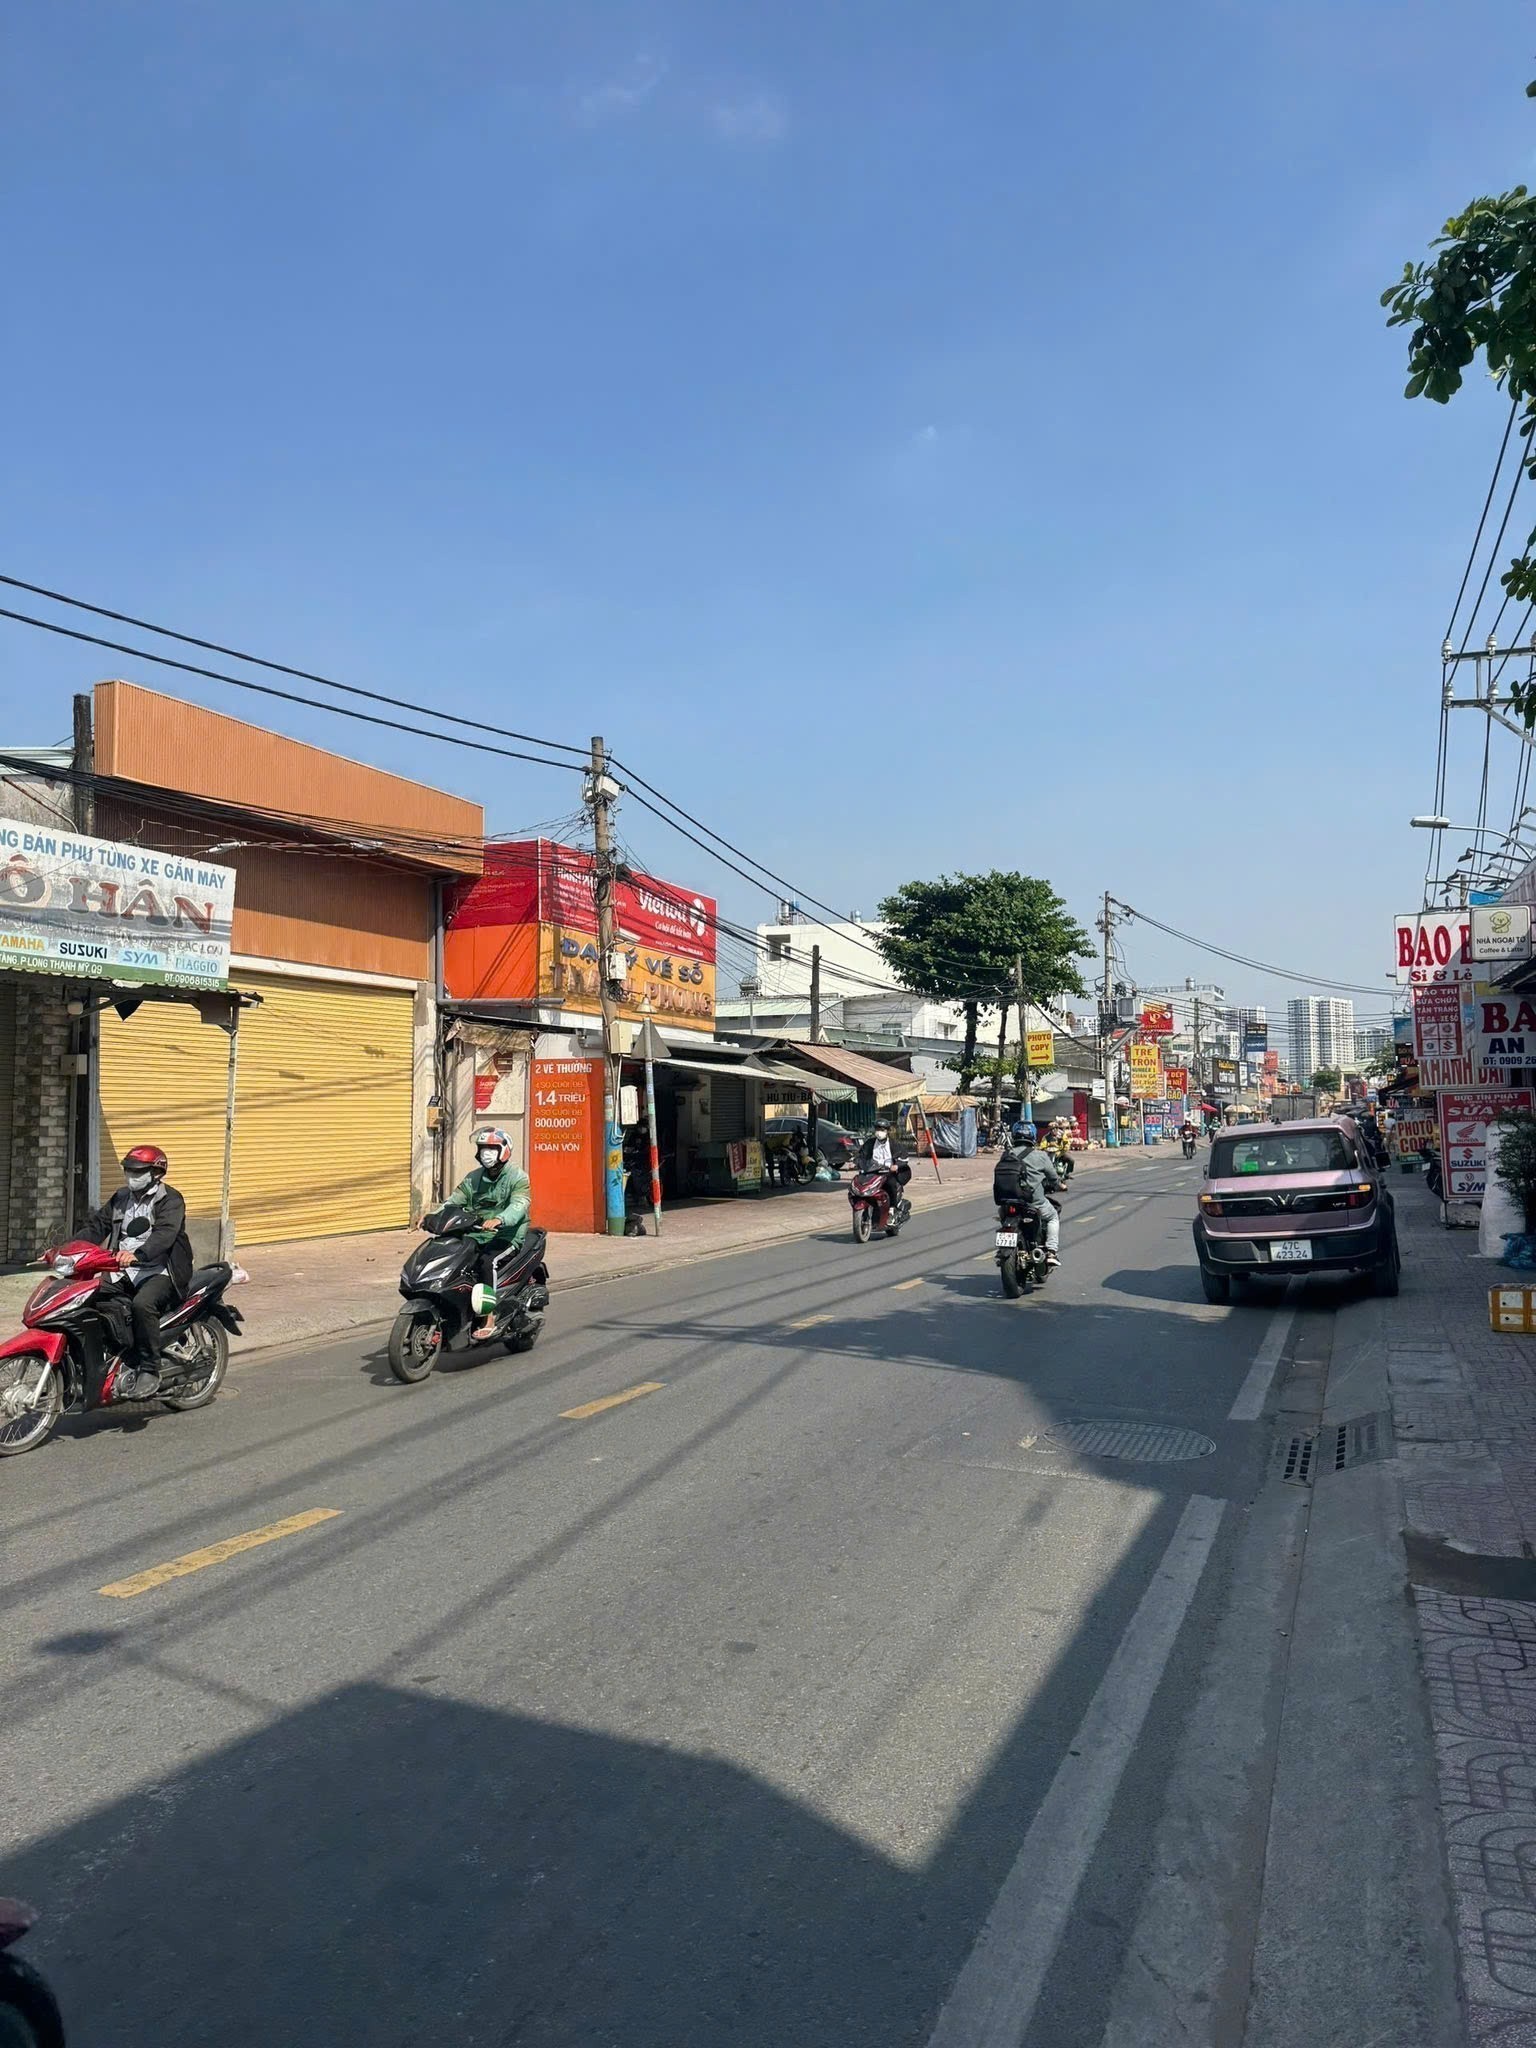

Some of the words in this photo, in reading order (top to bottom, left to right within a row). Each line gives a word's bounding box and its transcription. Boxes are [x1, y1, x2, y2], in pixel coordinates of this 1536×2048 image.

[23, 831, 56, 855] BÁN
[61, 841, 93, 866] PHỤ
[141, 857, 160, 876] XE
[164, 858, 193, 883] GẮN
[197, 869, 226, 889] MÁY
[60, 942, 108, 959] SUZUKI
[1398, 927, 1451, 967] BAO
[123, 950, 159, 965] SYM
[645, 956, 673, 980] VÉ
[678, 962, 705, 986] SỐ
[1433, 970, 1448, 981] &
[1027, 1034, 1052, 1042] PHOTO
[1031, 1043, 1049, 1052] COPY
[1488, 1037, 1525, 1054] AN
[1499, 1056, 1523, 1065] 0909
[535, 1064, 544, 1074] 2
[535, 1090, 557, 1106] 1.4
[1447, 1103, 1494, 1117] SỬA
[1398, 1120, 1433, 1136] PHOTO
[1457, 1182, 1486, 1192] SYM
[1282, 1241, 1300, 1250] 47C
[1276, 1249, 1308, 1259] 423.24
